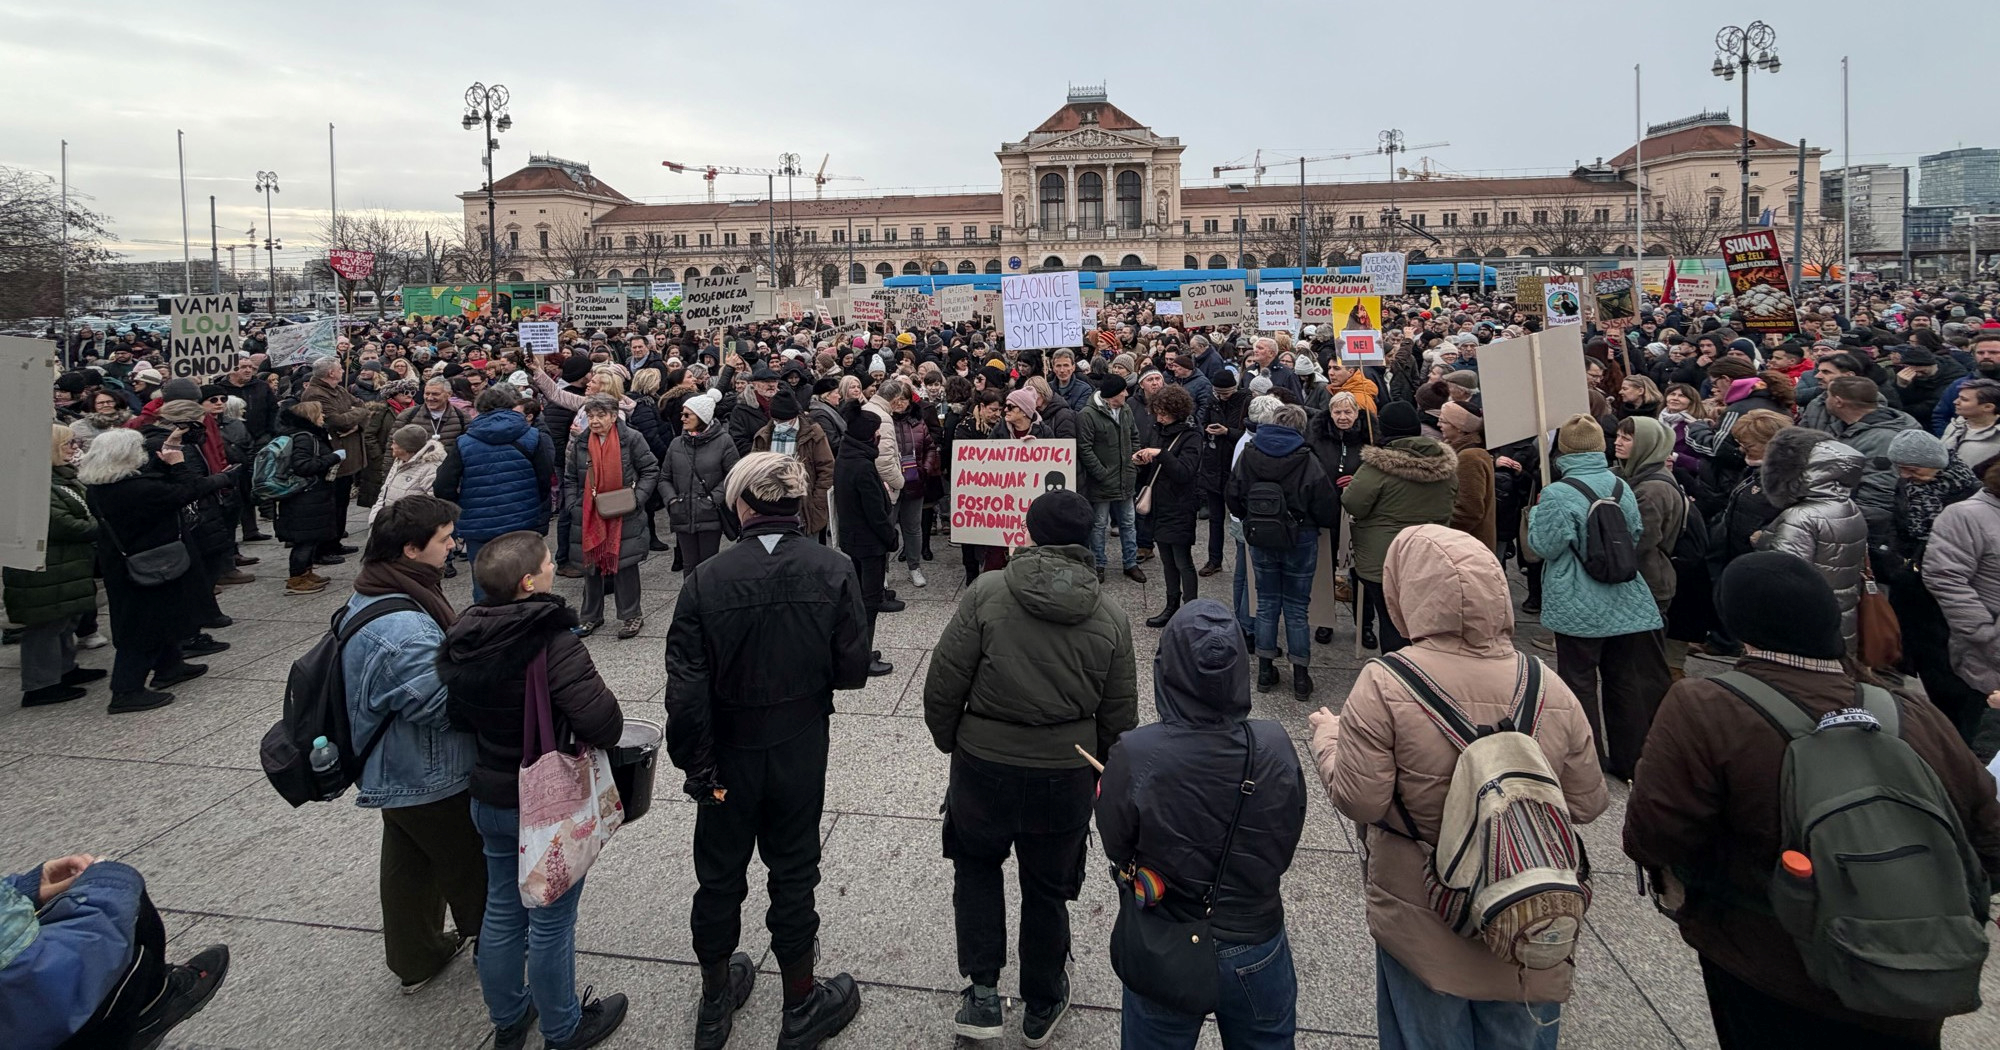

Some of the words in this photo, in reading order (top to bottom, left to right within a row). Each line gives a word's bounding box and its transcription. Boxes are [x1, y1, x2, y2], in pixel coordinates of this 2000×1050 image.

[1049, 154, 1079, 162] GLAVNI
[1087, 152, 1134, 160] KOLODVOR
[1725, 234, 1772, 254] SUNJA
[1366, 255, 1398, 265] VELIKA
[1735, 253, 1746, 262] NE
[1748, 250, 1765, 260] ŽELI
[1365, 265, 1398, 273] LUDINA
[694, 275, 740, 288] TRAJNE
[1304, 274, 1370, 284] NEVJEROJATNIH
[1549, 274, 1566, 286] NO
[1568, 275, 1576, 287] A
[736, 288, 748, 298] ZA
[1003, 275, 1071, 300] KLAONICE
[1187, 286, 1207, 298] 620
[1210, 283, 1234, 294] TONA
[174, 296, 234, 314] VAMA
[1193, 297, 1232, 309] ZAKLANIH
[686, 305, 720, 320] OKOLIŠ
[1005, 299, 1074, 323] TVORNICE
[1307, 308, 1332, 316] GODI
[181, 314, 234, 334] LOJ,
[708, 314, 743, 326] PROFITA
[1602, 317, 1633, 330] SISAK
[1012, 322, 1064, 348] SMRTI
[174, 334, 235, 357] NAMA
[1353, 340, 1368, 350] NE!
[174, 353, 240, 377] GNOJ!
[957, 468, 1027, 489] AMONIJAK
[1033, 472, 1040, 488] I
[957, 494, 1015, 512] FOSFOR
